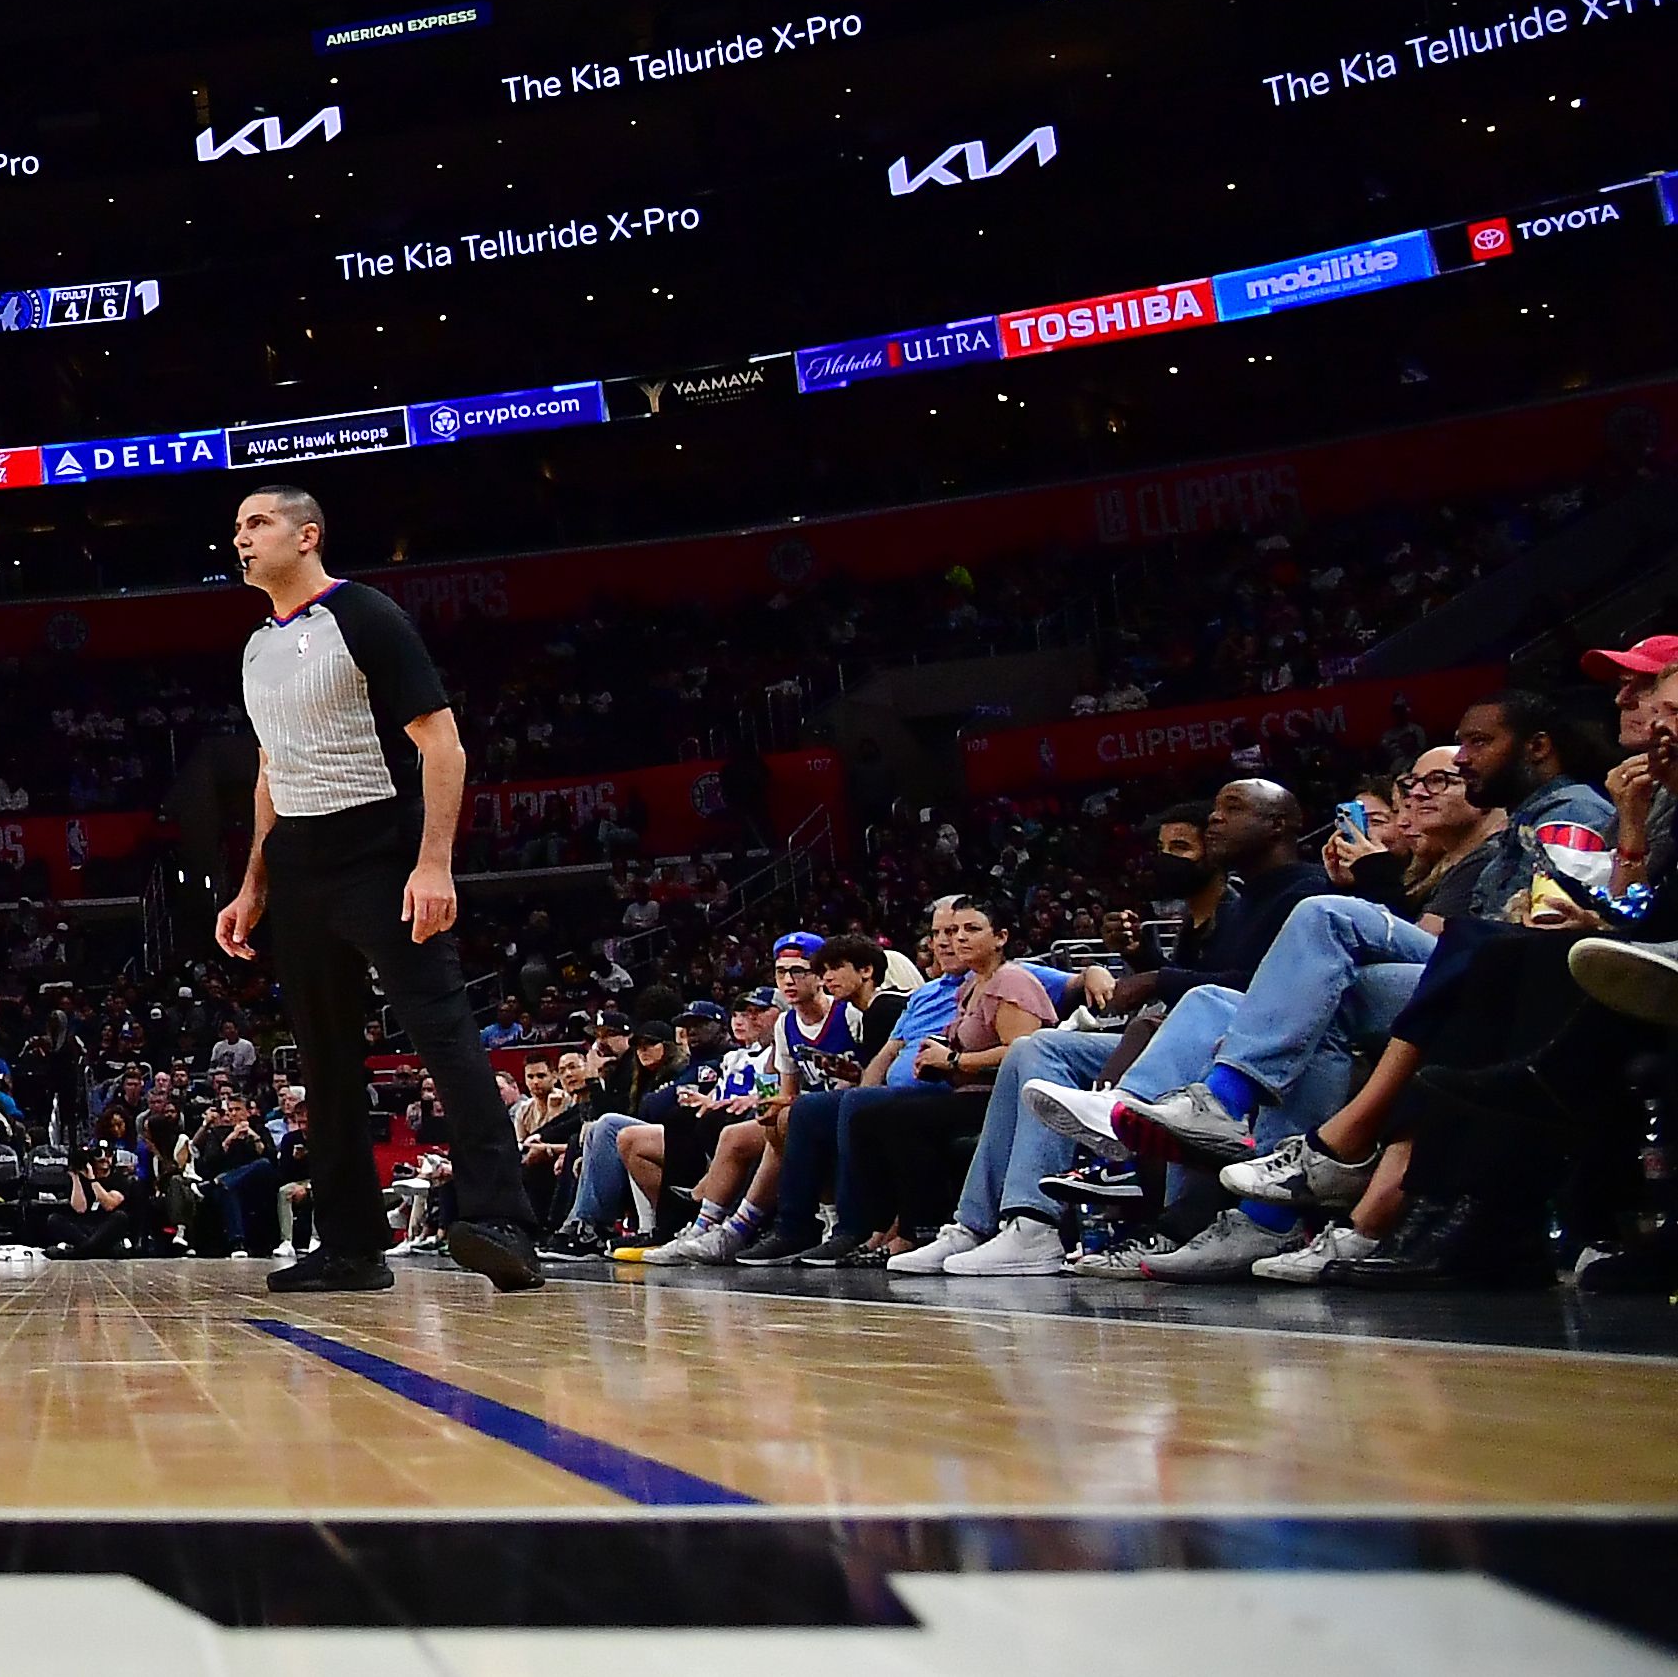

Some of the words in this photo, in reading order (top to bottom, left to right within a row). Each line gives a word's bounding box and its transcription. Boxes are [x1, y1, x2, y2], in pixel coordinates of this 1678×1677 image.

[327, 22, 403, 46] AMERICAN
[408, 9, 476, 31] EXPRESS
[501, 75, 561, 102] The
[572, 64, 620, 92] Kia
[629, 35, 763, 81] Telluride
[772, 15, 861, 53] X-Pro
[1263, 72, 1329, 106] The
[1340, 52, 1396, 87] Kia
[1405, 7, 1567, 68] Telluride
[1518, 204, 1620, 240] TOYOTA
[335, 252, 393, 280] The
[404, 243, 451, 271] Kia
[461, 220, 597, 261] Telluride
[607, 208, 699, 241] X-Pro
[1246, 247, 1398, 301] mobilitie
[1011, 291, 1203, 347] TOSHIBA
[903, 331, 991, 361] ULTRA
[464, 396, 580, 426] crypto.com
[94, 439, 214, 470] DELTA
[246, 436, 289, 457] AVAC
[293, 431, 335, 449] Hawk
[340, 425, 390, 446] Hoops
